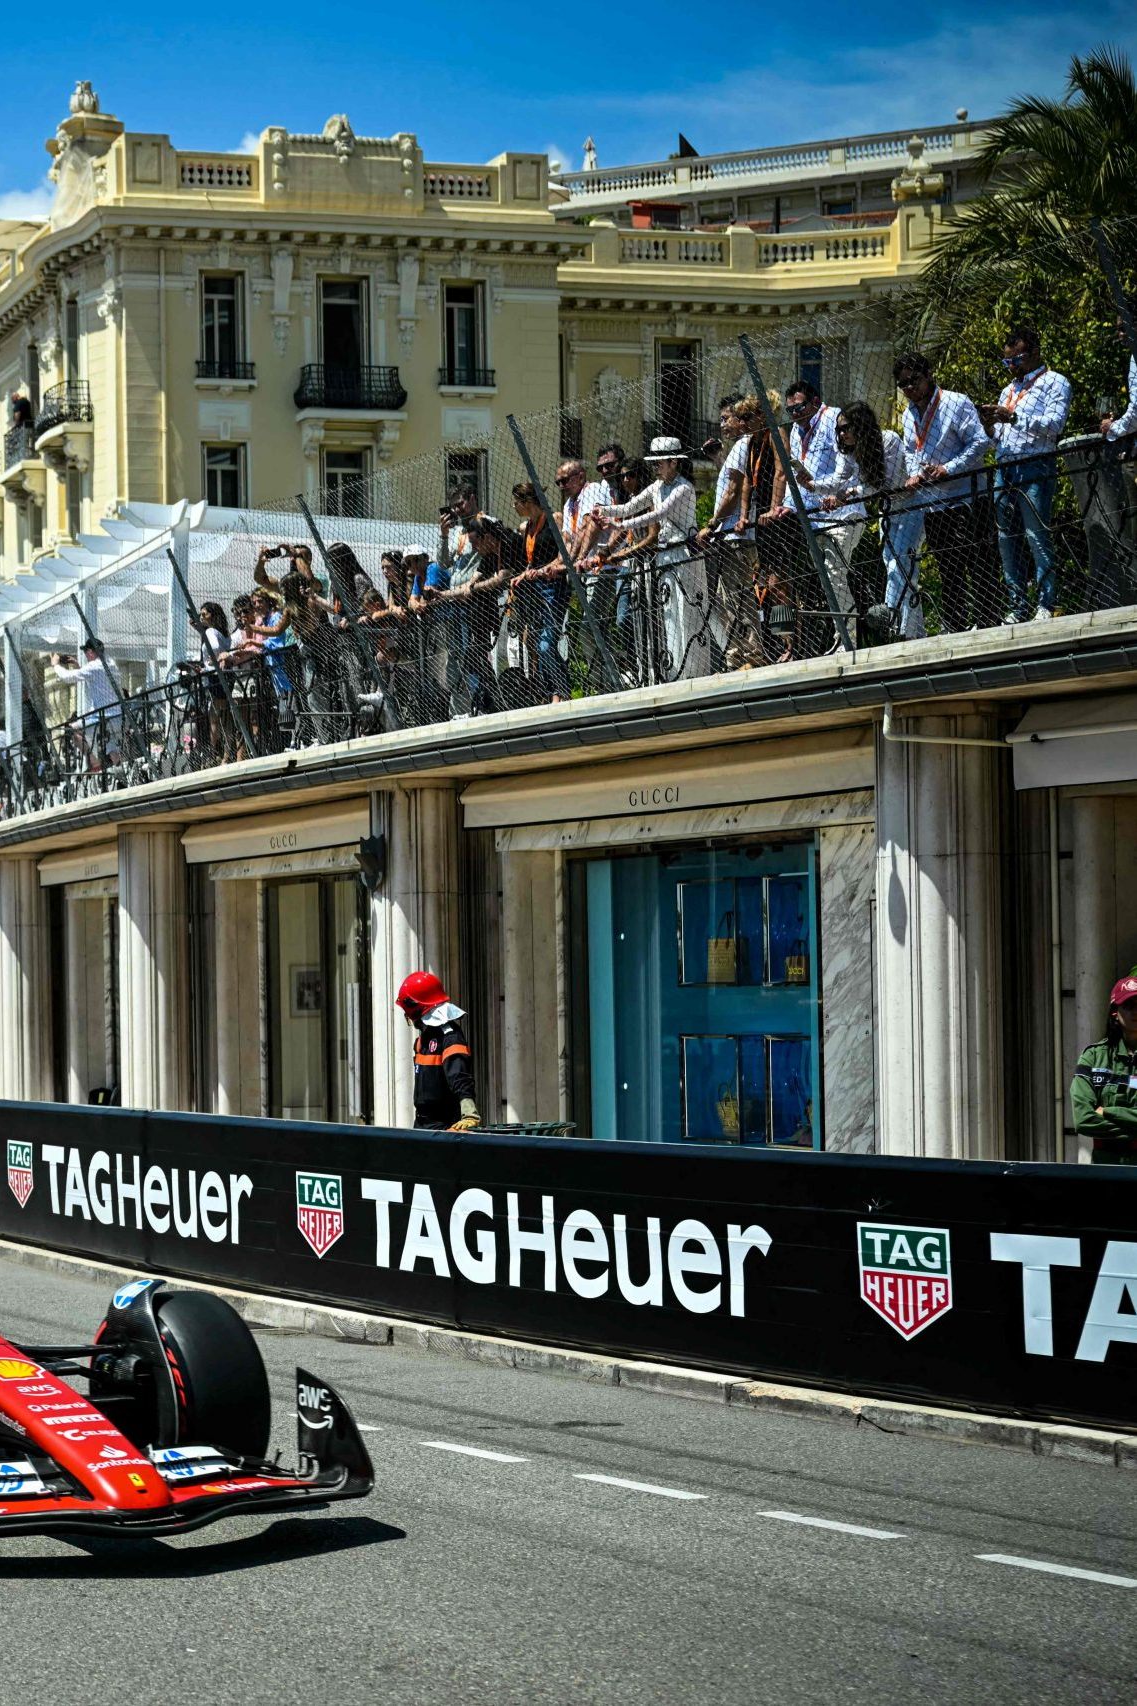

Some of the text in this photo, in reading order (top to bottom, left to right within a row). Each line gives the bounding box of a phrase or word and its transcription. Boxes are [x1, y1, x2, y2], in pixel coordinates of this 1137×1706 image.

[628, 787, 680, 807] GUCCI
[269, 833, 297, 849] GUCCI
[9, 1145, 31, 1167] TAG
[9, 1169, 32, 1205] HEUER
[300, 1178, 339, 1206] TAG
[300, 1208, 341, 1251] HEUER
[865, 1231, 942, 1270] TAG
[866, 1275, 946, 1330] HEUER
[17, 1384, 57, 1393] aws
[298, 1383, 332, 1411] aws
